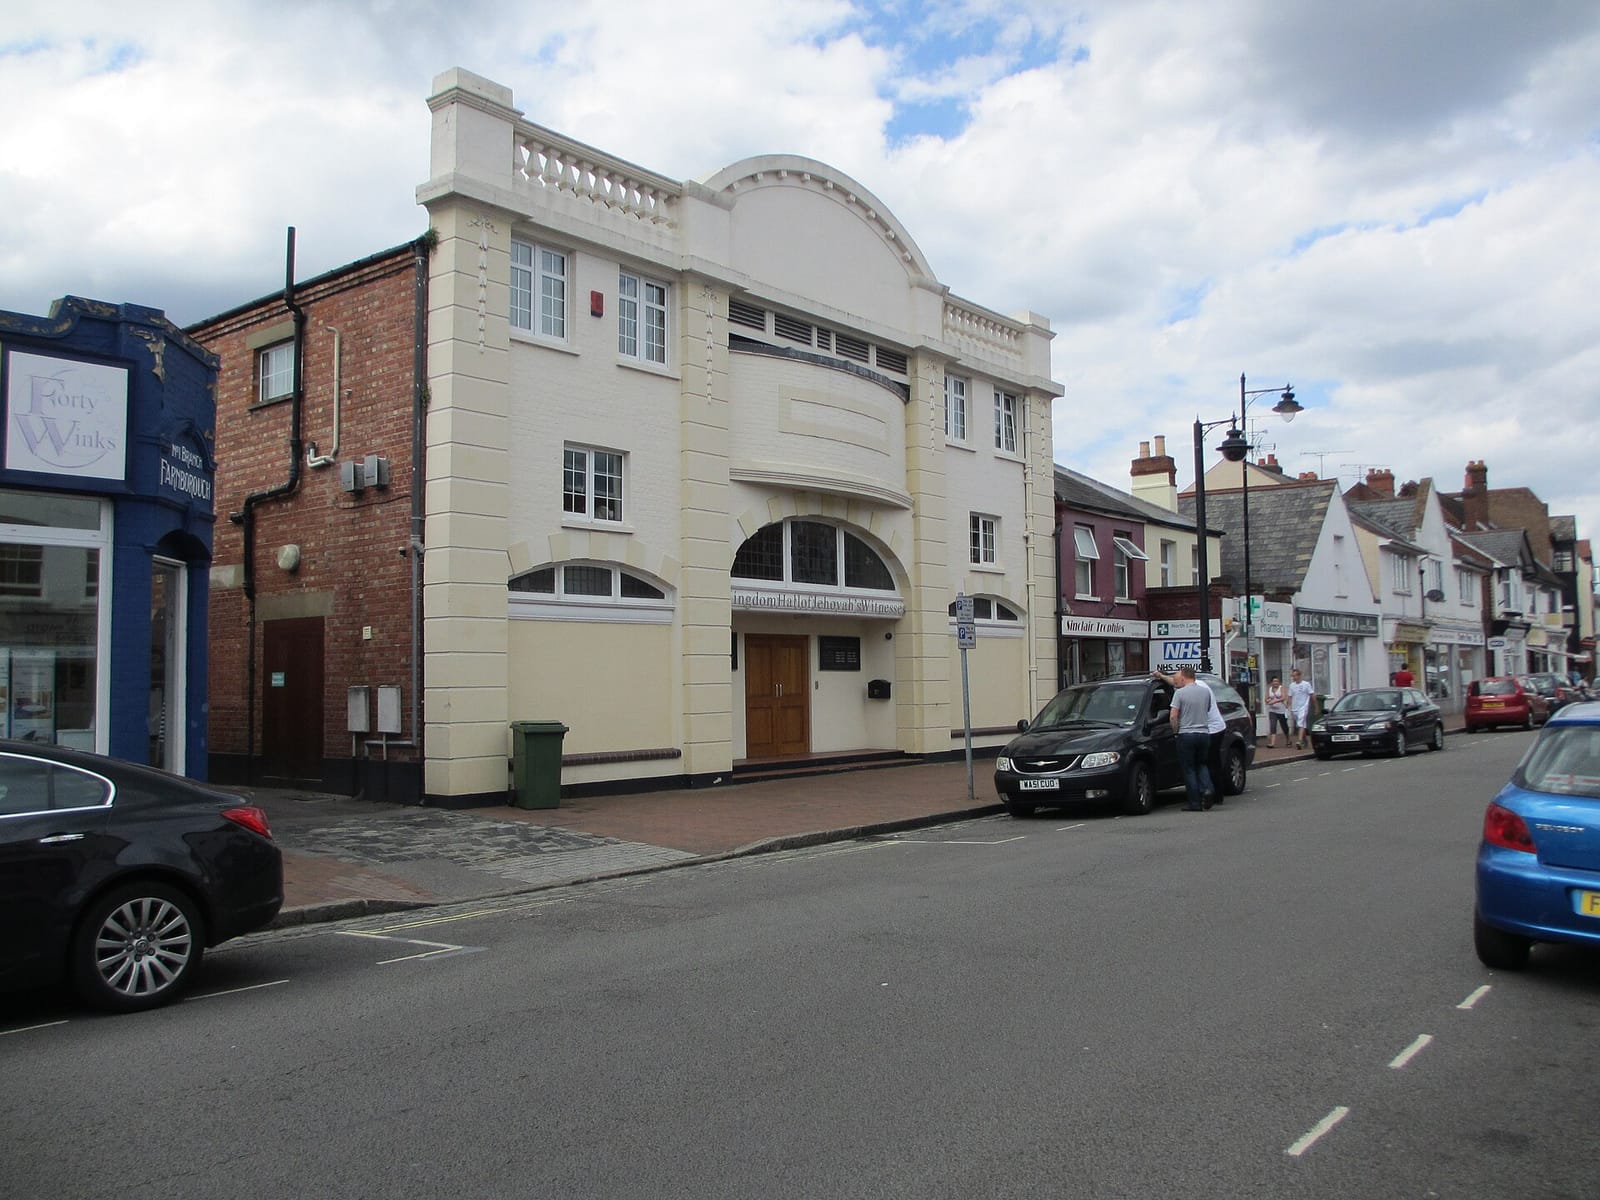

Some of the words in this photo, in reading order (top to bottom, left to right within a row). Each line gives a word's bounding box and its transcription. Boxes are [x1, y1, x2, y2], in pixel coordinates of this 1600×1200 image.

[24, 374, 97, 415] Forty
[14, 412, 117, 457] Winks
[733, 590, 776, 609] ingdom
[1066, 620, 1094, 632] Sinclair
[1164, 643, 1202, 659] NHS
[1156, 663, 1174, 671] NHS
